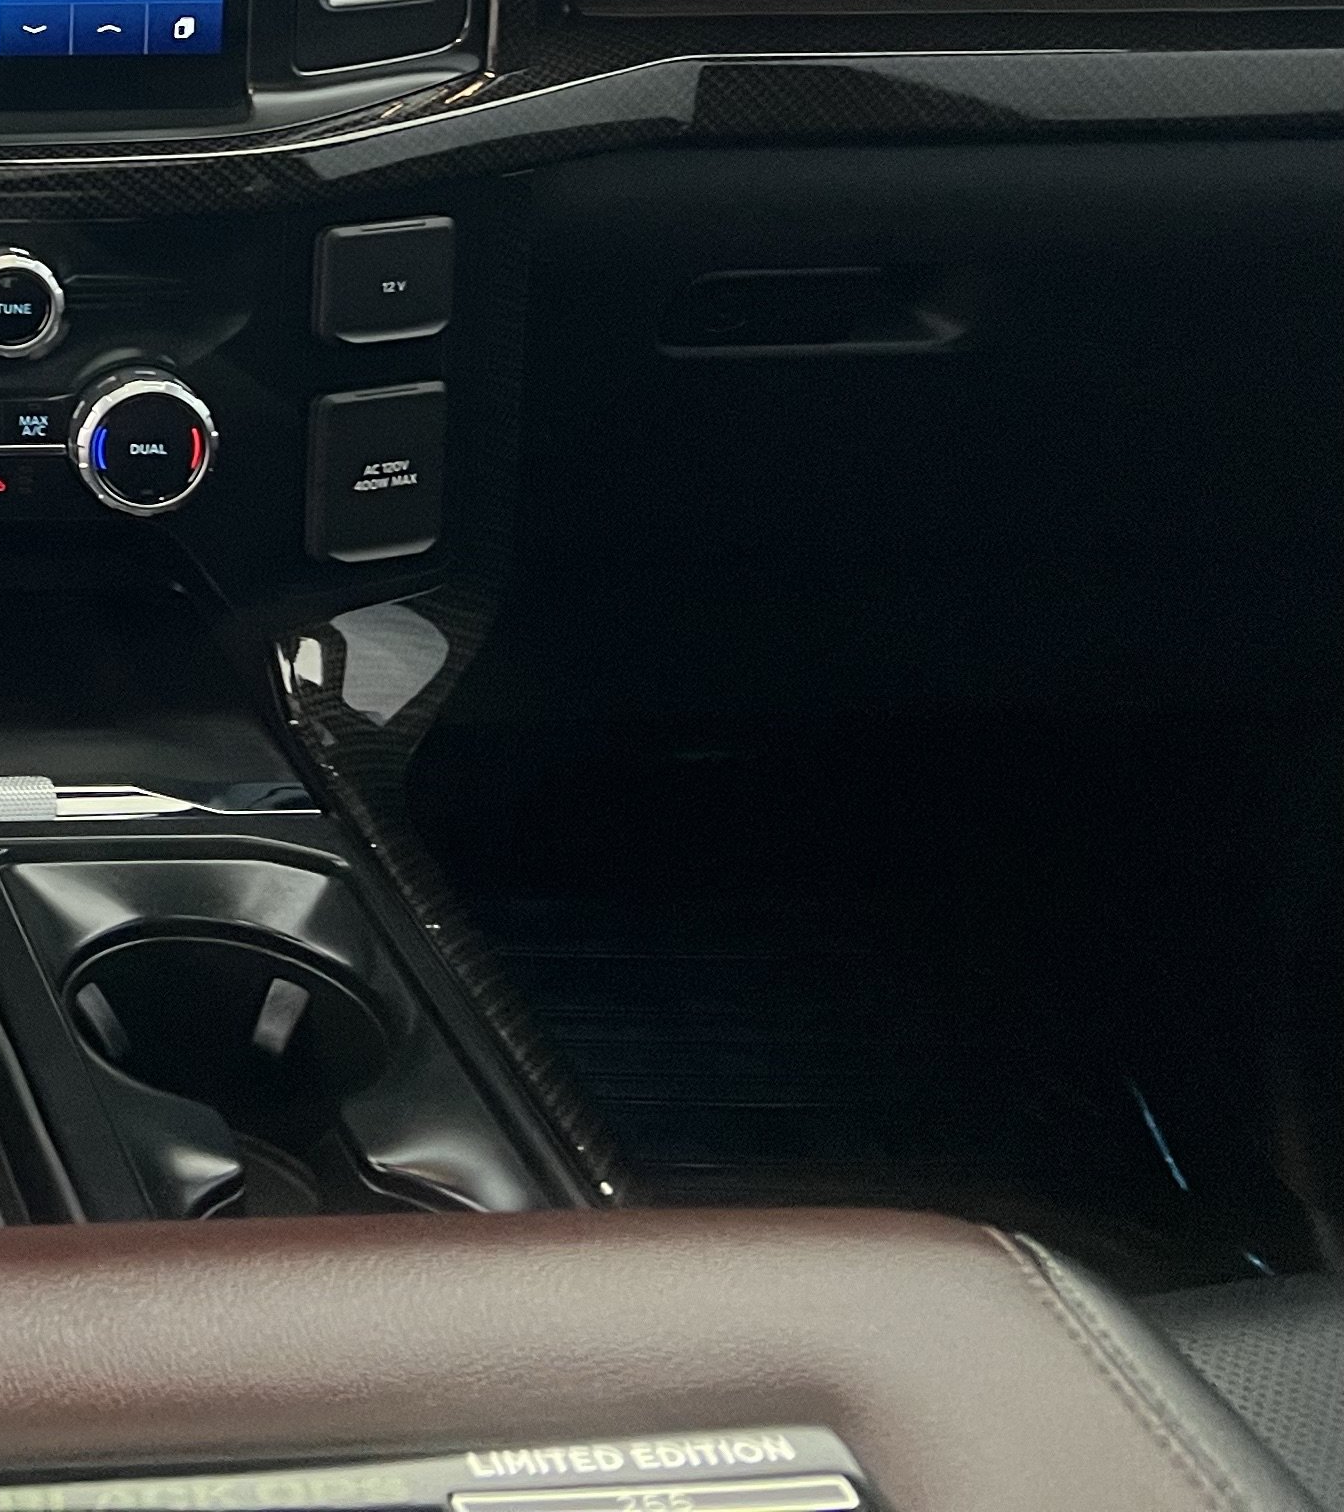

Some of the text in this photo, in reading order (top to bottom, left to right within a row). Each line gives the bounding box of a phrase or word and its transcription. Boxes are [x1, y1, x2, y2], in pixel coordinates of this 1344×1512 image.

[382, 281, 396, 293] 12
[18, 416, 49, 426] MAX
[21, 425, 47, 437] A/C
[130, 443, 167, 456] DUAL
[390, 473, 418, 487] MAX
[467, 1433, 796, 1478] LIMITED EDITION
